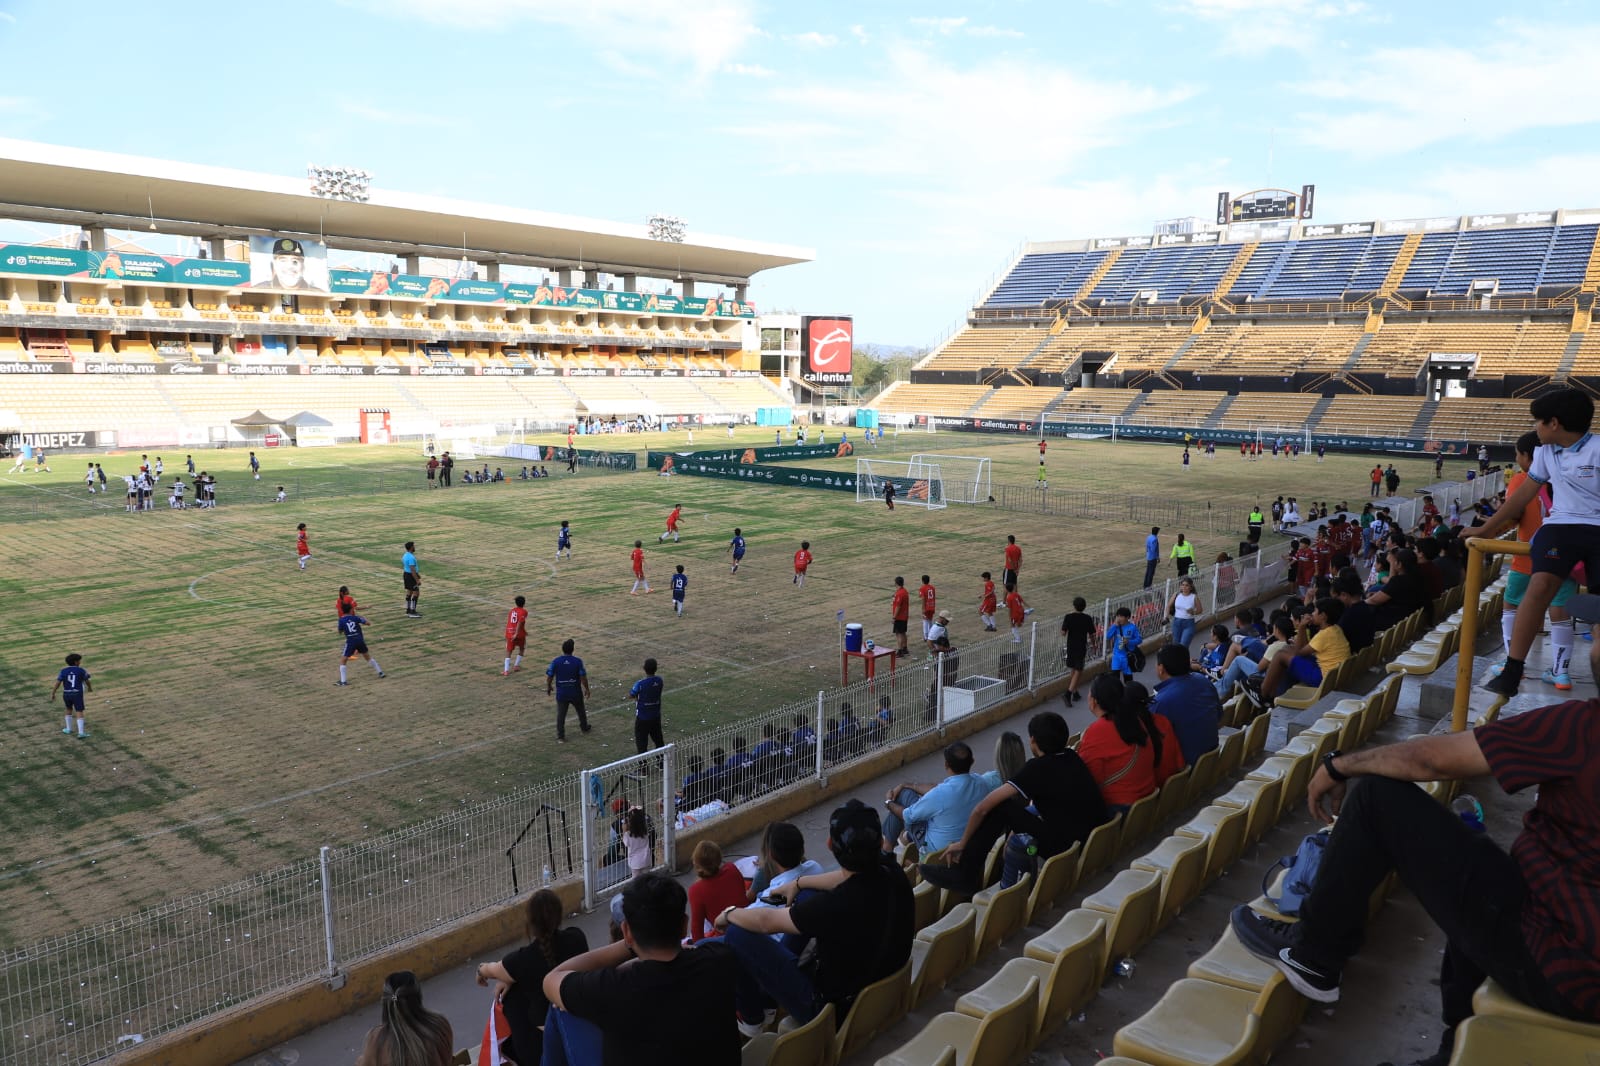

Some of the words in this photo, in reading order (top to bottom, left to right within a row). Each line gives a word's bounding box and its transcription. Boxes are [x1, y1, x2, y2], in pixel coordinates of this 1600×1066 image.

[87, 362, 156, 374] caliente.mx
[229, 363, 288, 374] caliente.mx
[311, 364, 364, 375] caliente.mx
[419, 366, 465, 375] caliente.mx
[482, 366, 525, 375] caliente.mx
[570, 368, 607, 377] caliente.mx
[981, 420, 1018, 430] caliente.mx
[346, 621, 358, 633] 12
[67, 673, 76, 688] 4
